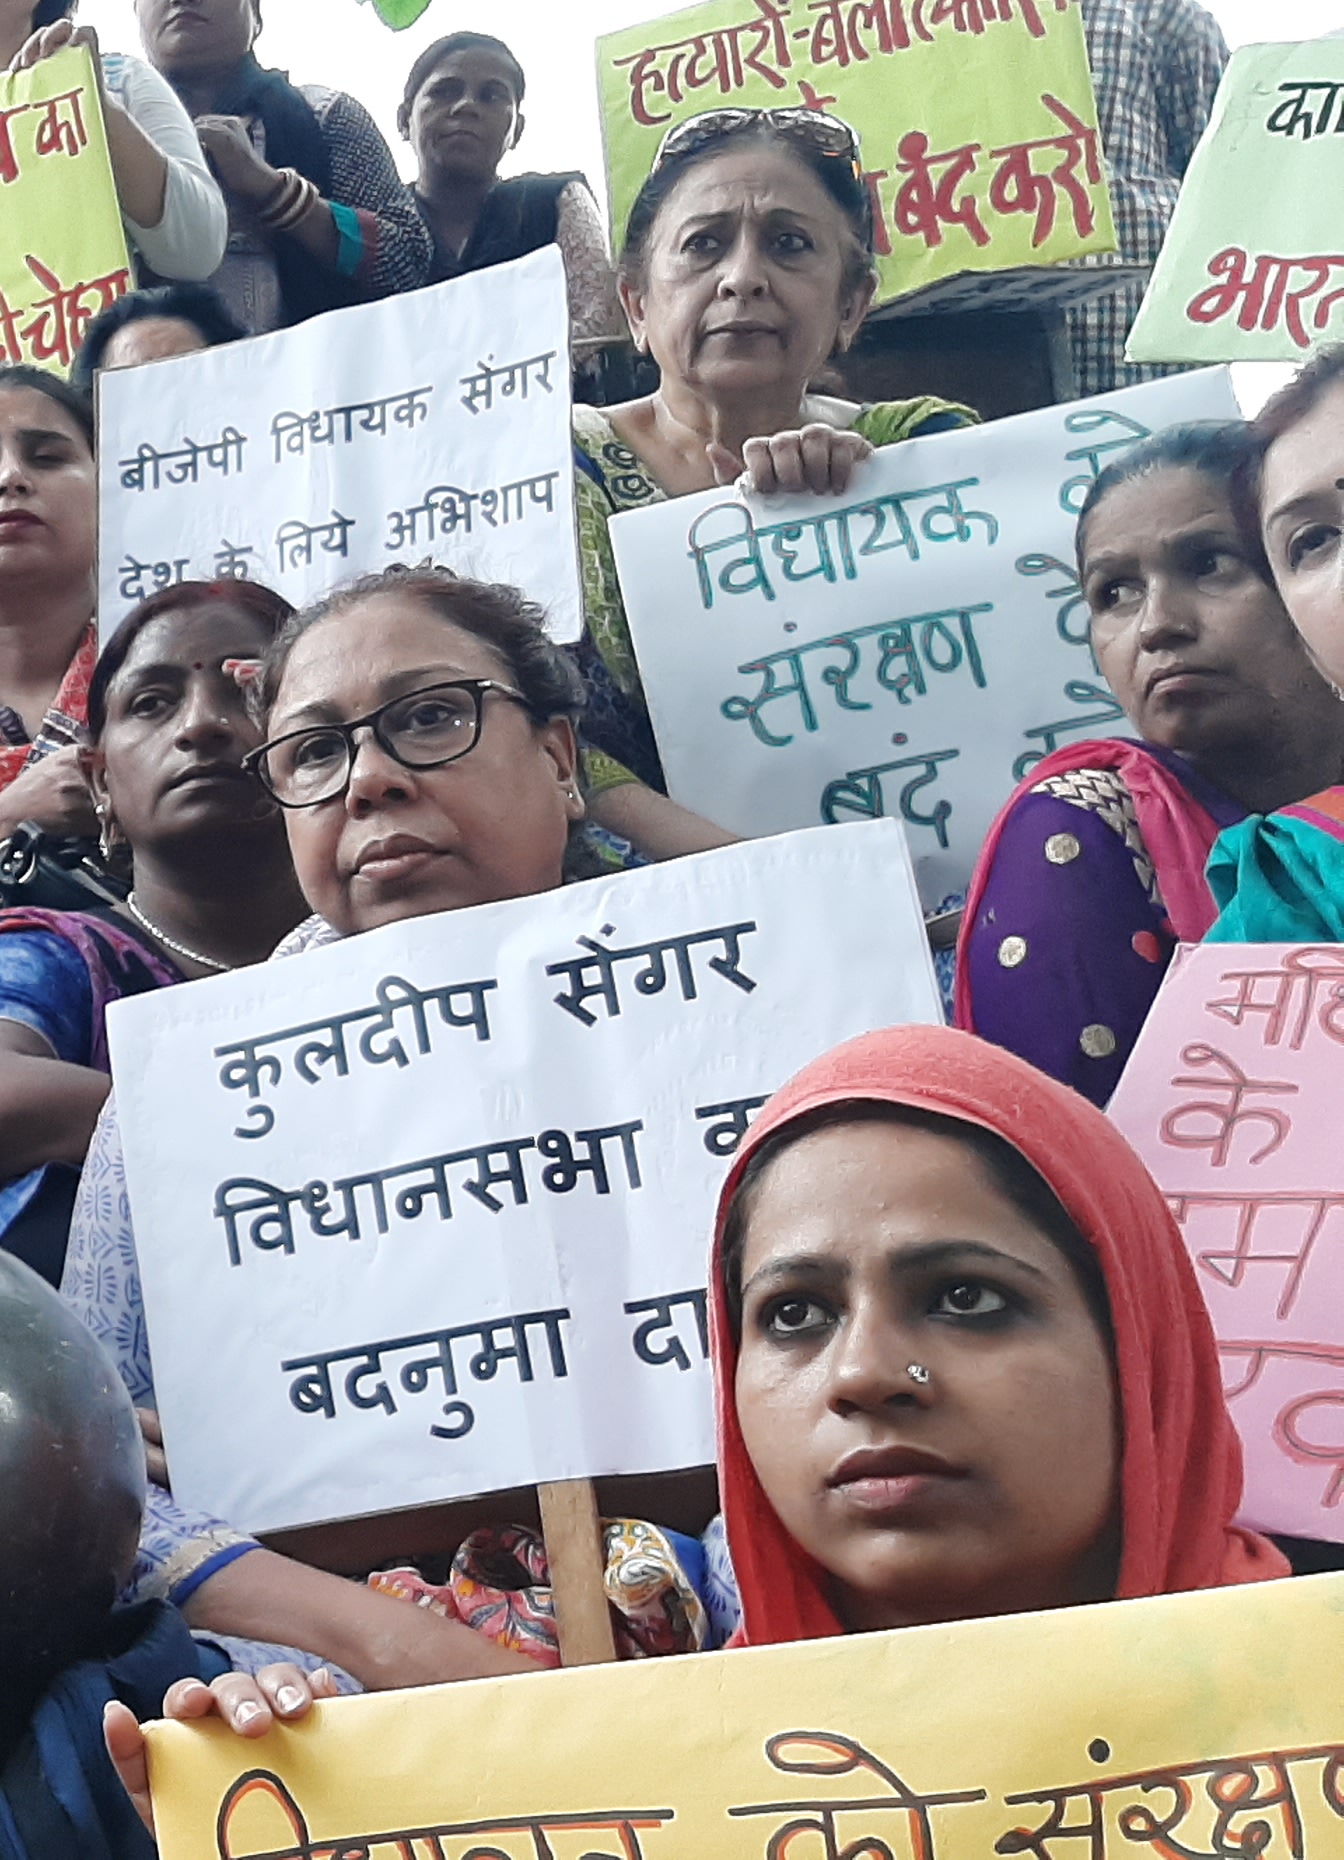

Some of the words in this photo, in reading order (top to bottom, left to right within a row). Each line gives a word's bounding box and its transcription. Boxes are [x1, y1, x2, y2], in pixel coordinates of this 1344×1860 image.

[31, 87, 88, 157] का
[894, 131, 991, 248] बंद
[989, 94, 1102, 248] करो
[118, 426, 248, 492] बीजेपी
[270, 386, 433, 464] विधायक
[459, 352, 557, 415] सेंगर
[275, 511, 356, 574] लिये
[384, 472, 561, 550] अभिशाप
[687, 477, 999, 609] विधायक
[719, 604, 994, 748] संरक्षण
[820, 733, 960, 849] बंद
[213, 974, 498, 1140] कुलदीप
[545, 921, 757, 1028] सेंगर
[1159, 1042, 1299, 1168] के
[213, 1119, 644, 1267] विधानसभा
[281, 1308, 570, 1440] बदनुमा
